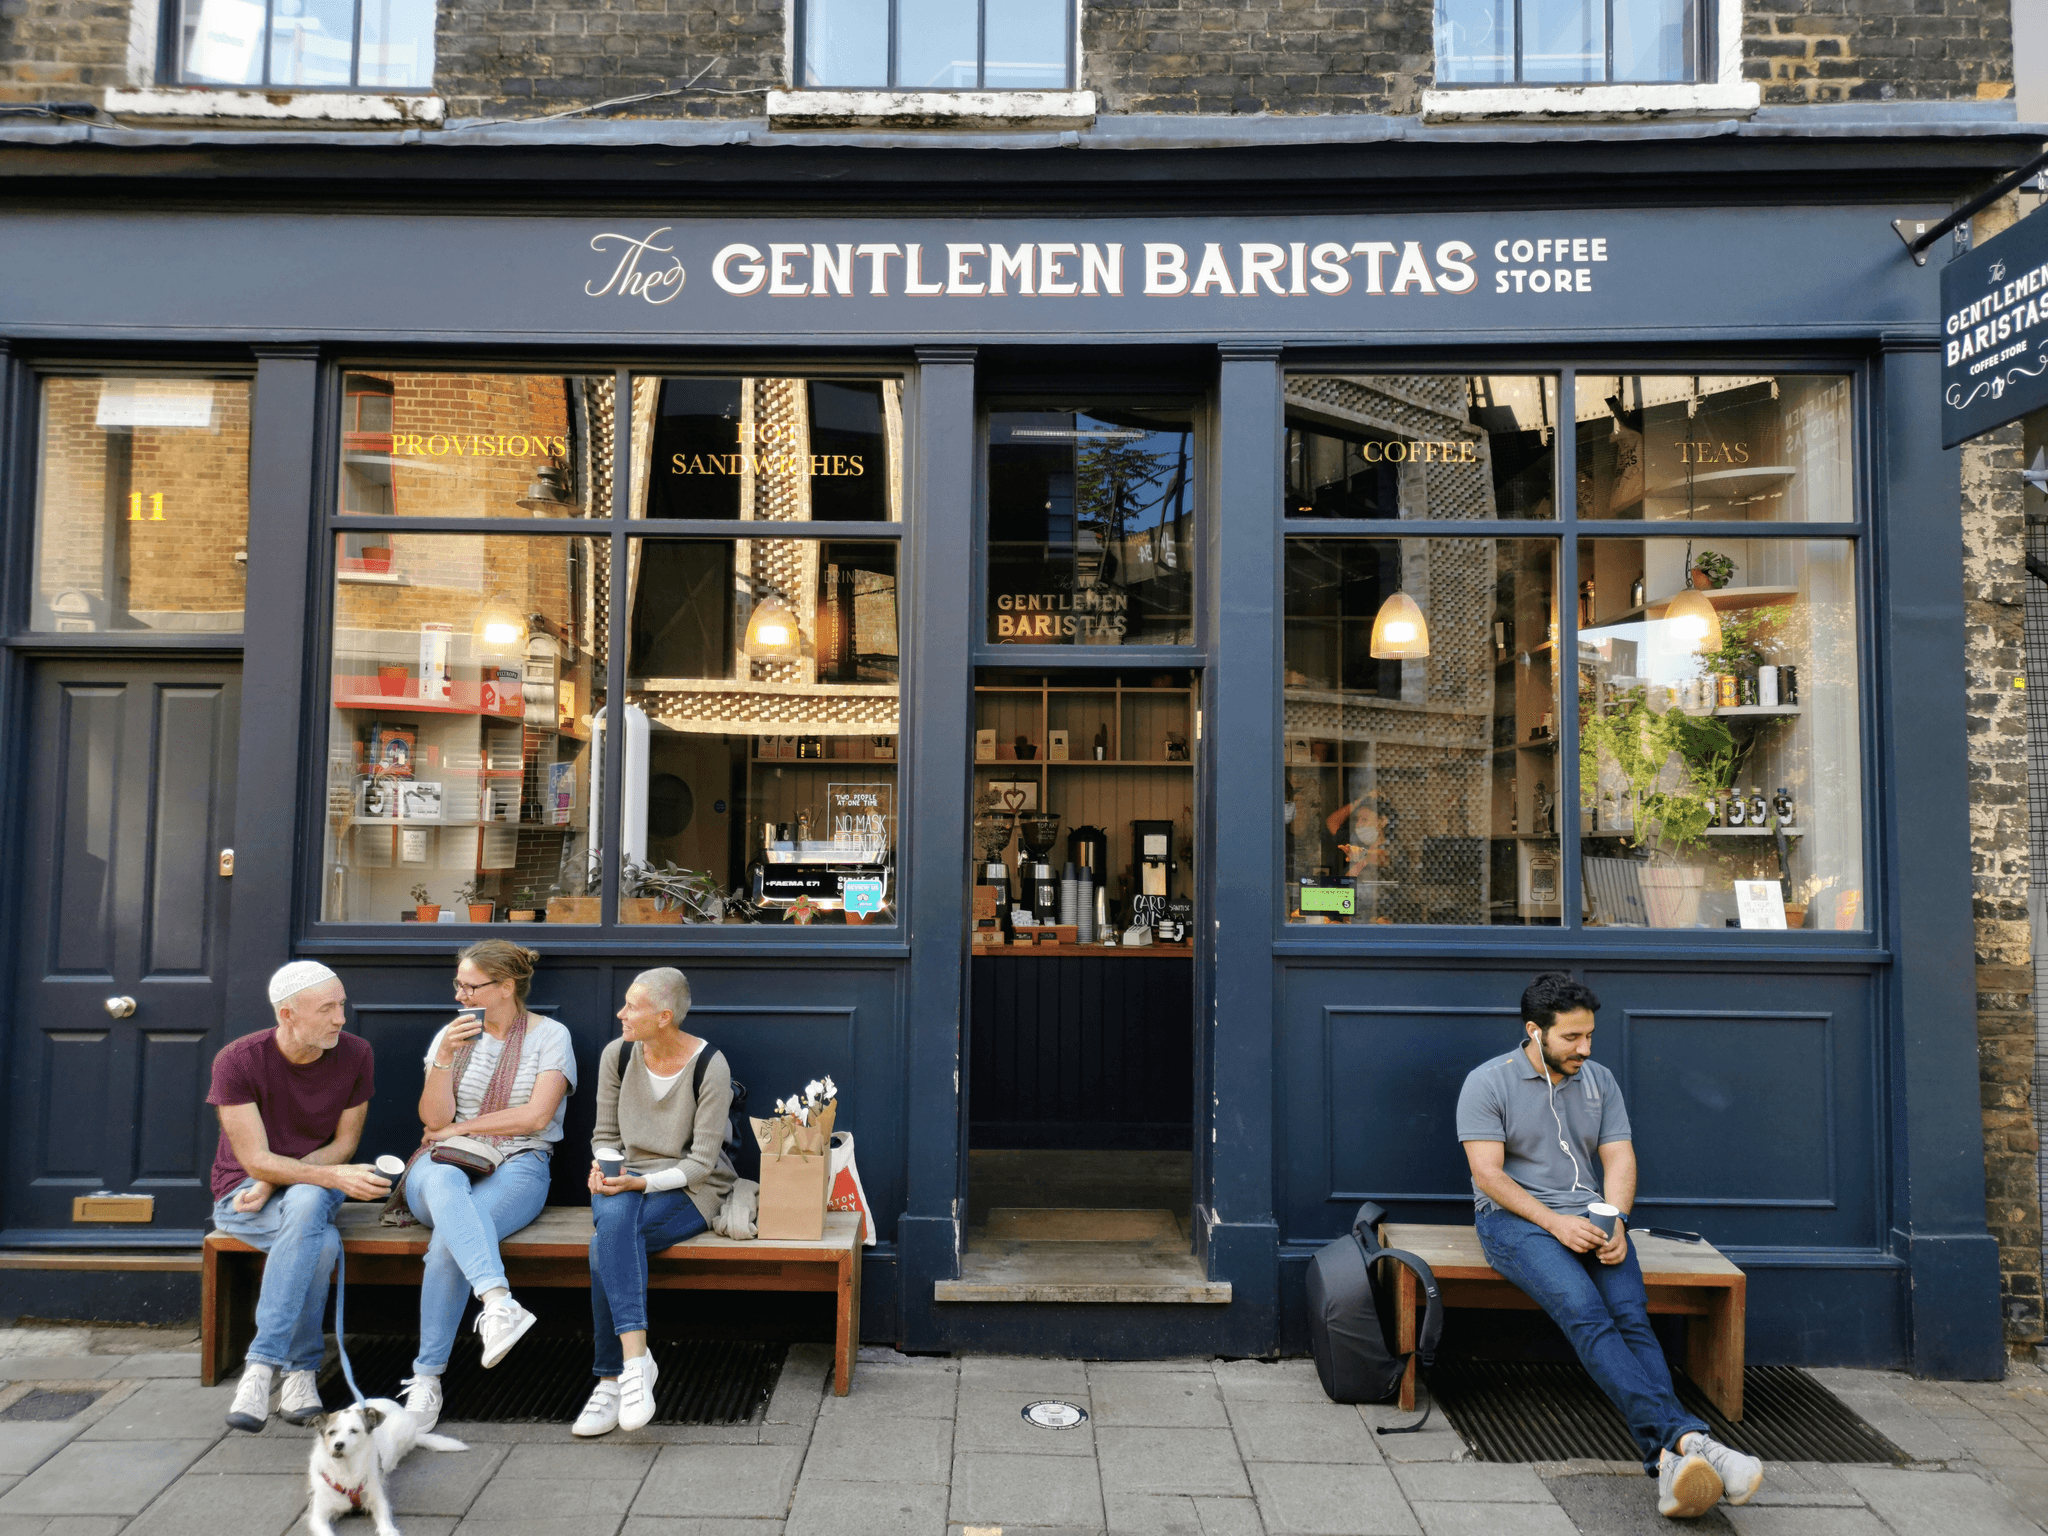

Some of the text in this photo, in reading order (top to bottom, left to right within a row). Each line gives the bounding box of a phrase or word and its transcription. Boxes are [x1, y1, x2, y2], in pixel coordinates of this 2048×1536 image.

[1494, 237, 1608, 263] COFFEE
[584, 226, 1478, 305] The GENTLEMEN BARISTAS
[1988, 258, 2006, 285] The
[1494, 268, 1593, 294] STORE
[1969, 339, 2028, 376] COFFEE STORE
[735, 422, 800, 445] HOT
[390, 434, 567, 458] PROVISIONS
[1362, 440, 1477, 463] COFFEE
[1674, 441, 1750, 463] TEAS
[671, 453, 866, 477] SANDWICHES
[127, 491, 167, 521] 11
[997, 594, 1128, 611] GENTLEMEN
[997, 615, 1128, 637] BARISTAS
[853, 793, 877, 801] PEOPLE
[835, 814, 887, 834] NO MASK
[1133, 894, 1166, 914] CARD
